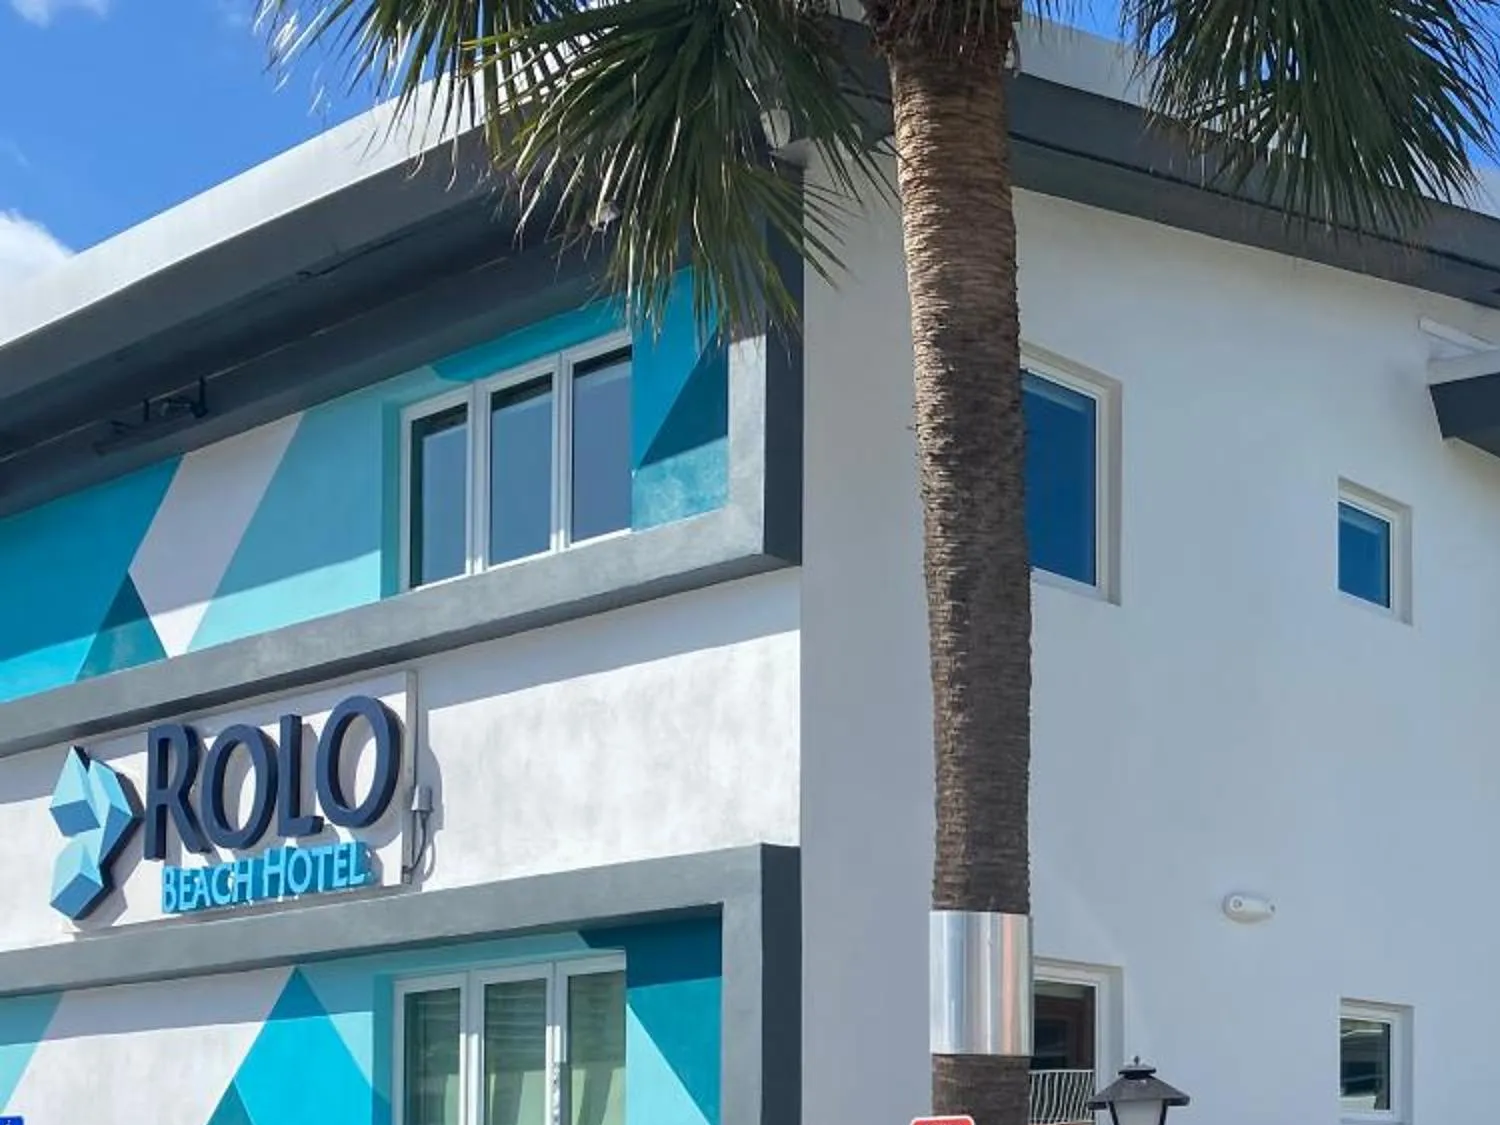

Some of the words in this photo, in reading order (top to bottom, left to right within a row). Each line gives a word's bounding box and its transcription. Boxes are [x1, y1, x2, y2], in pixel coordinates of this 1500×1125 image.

[144, 694, 404, 861] ROLO
[162, 857, 255, 914] BEACH
[262, 838, 371, 902] HOTEL
